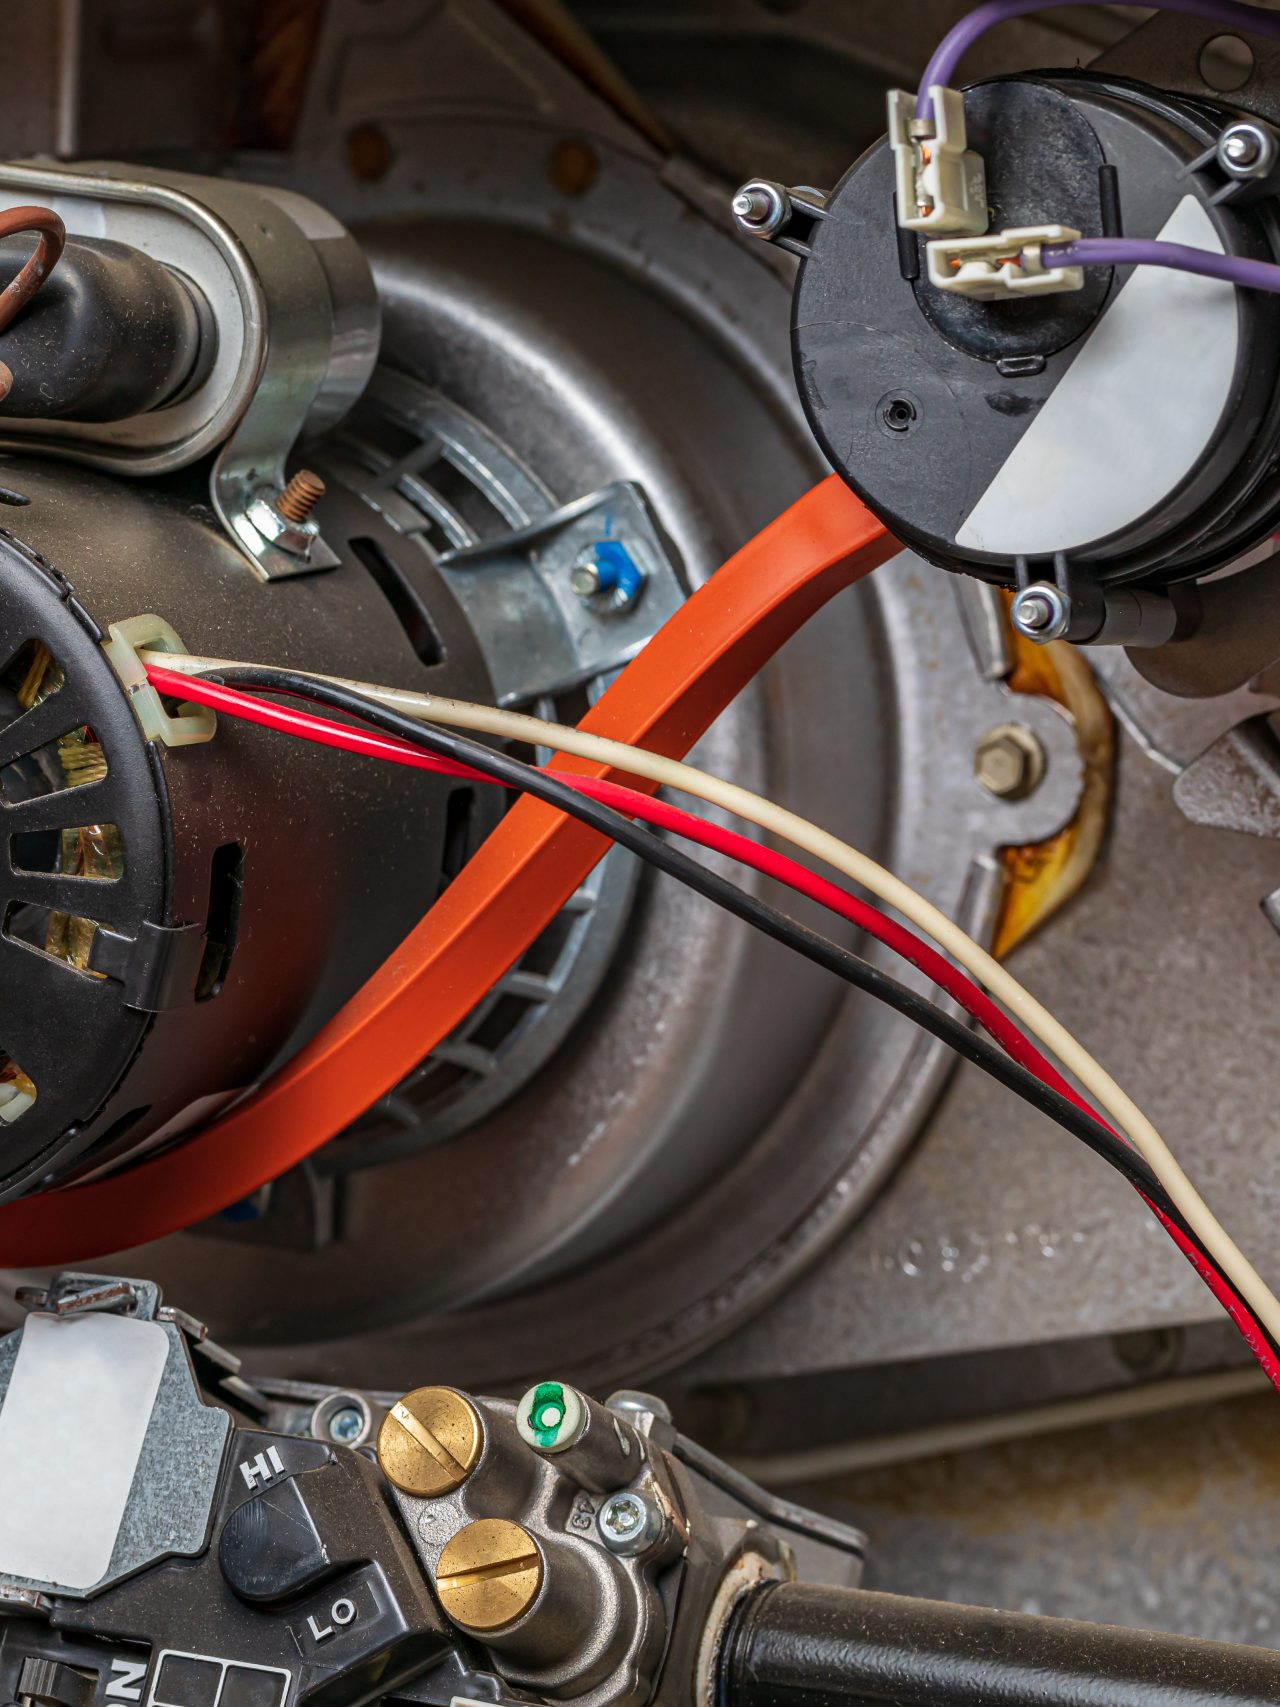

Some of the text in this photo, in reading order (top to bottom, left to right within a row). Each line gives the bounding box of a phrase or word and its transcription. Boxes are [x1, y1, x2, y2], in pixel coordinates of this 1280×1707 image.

[239, 1445, 285, 1490] HI
[306, 1598, 358, 1642] LO
[104, 1658, 148, 1707] N
